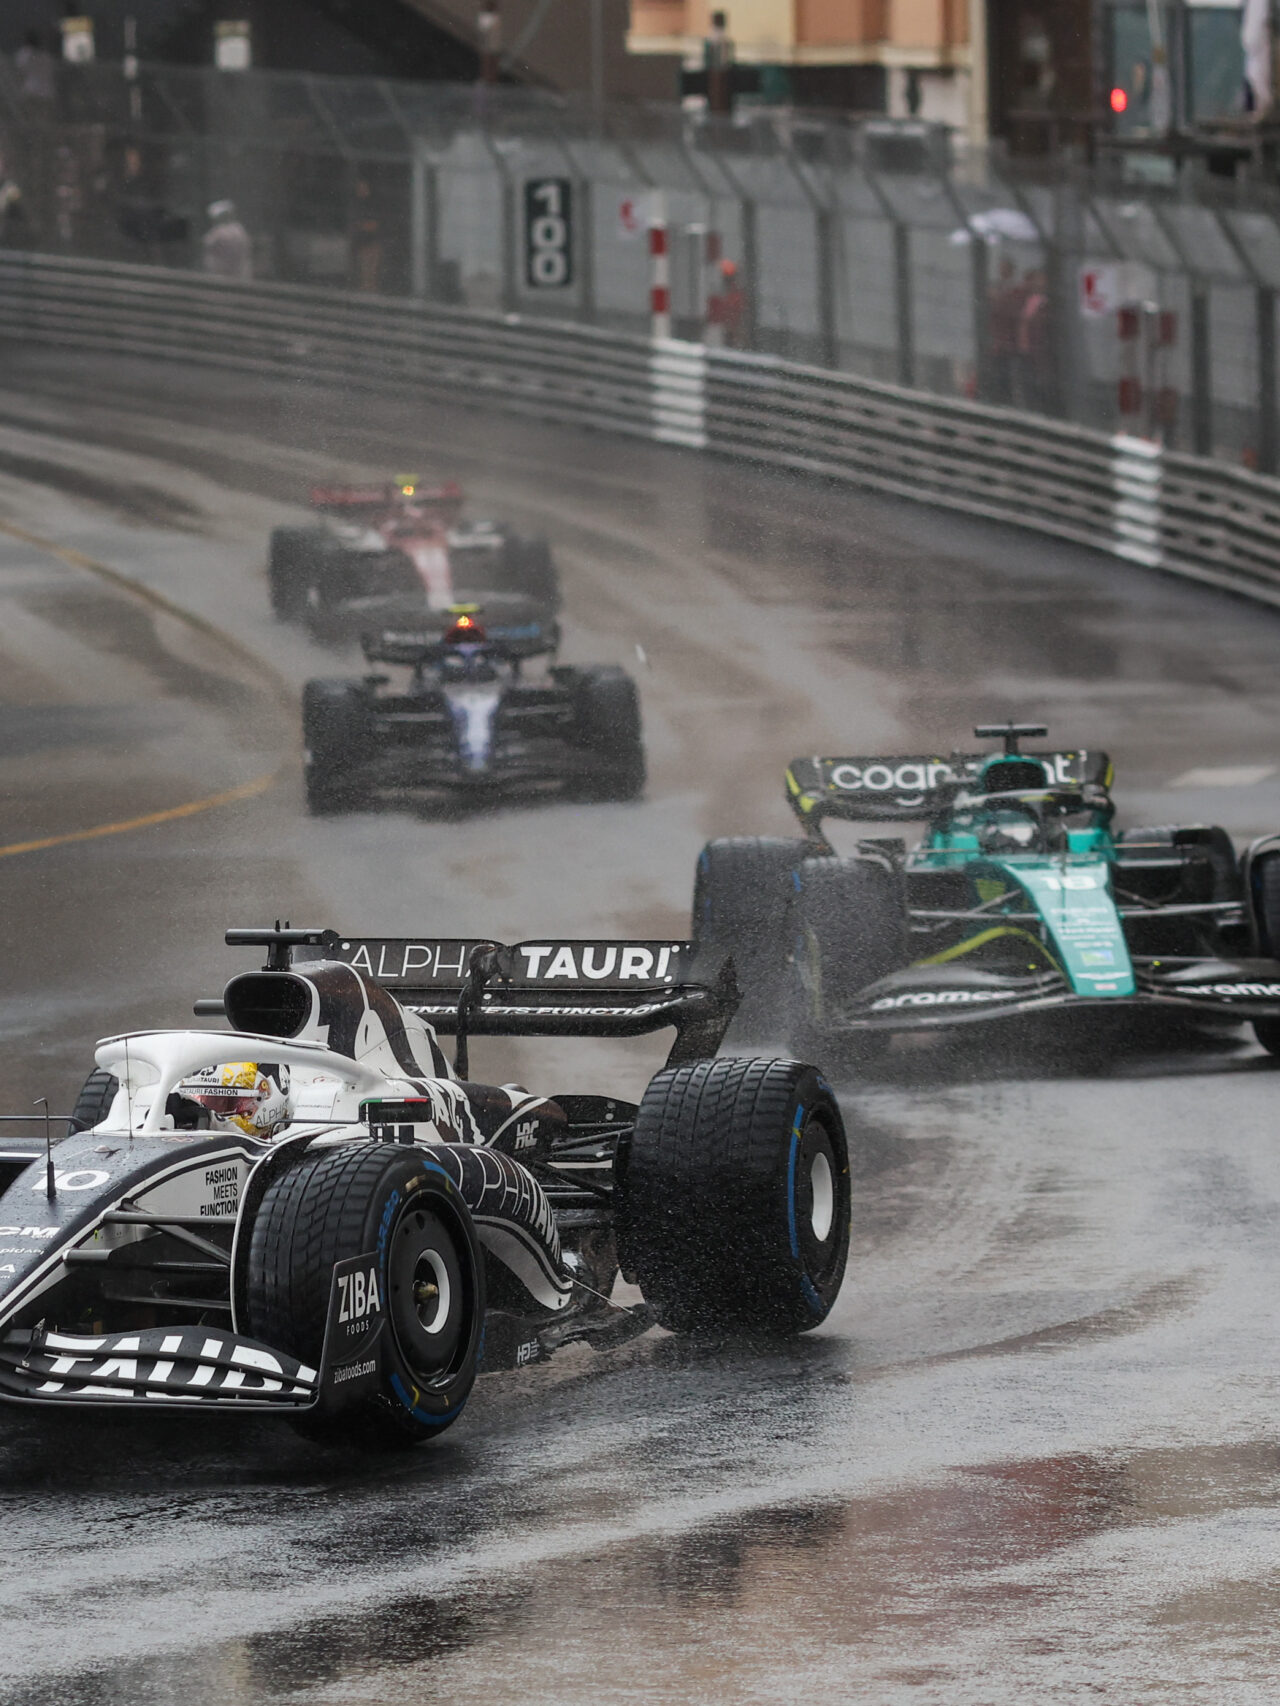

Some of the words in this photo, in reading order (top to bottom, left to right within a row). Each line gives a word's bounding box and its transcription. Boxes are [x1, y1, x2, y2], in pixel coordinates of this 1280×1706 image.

[532, 184, 566, 283] 100
[350, 944, 475, 978] ALPH
[520, 946, 670, 980] TAURI
[872, 990, 1018, 1010] aramco
[204, 1088, 238, 1096] FASHION
[32, 1169, 110, 1191] 10
[205, 1166, 238, 1186] FASHION
[213, 1182, 238, 1200] MEETS
[200, 1199, 238, 1216] FUNCTION
[337, 1267, 381, 1323] ZIBA
[346, 1319, 369, 1336] FOODS
[334, 1359, 376, 1384] zibafoods.com
